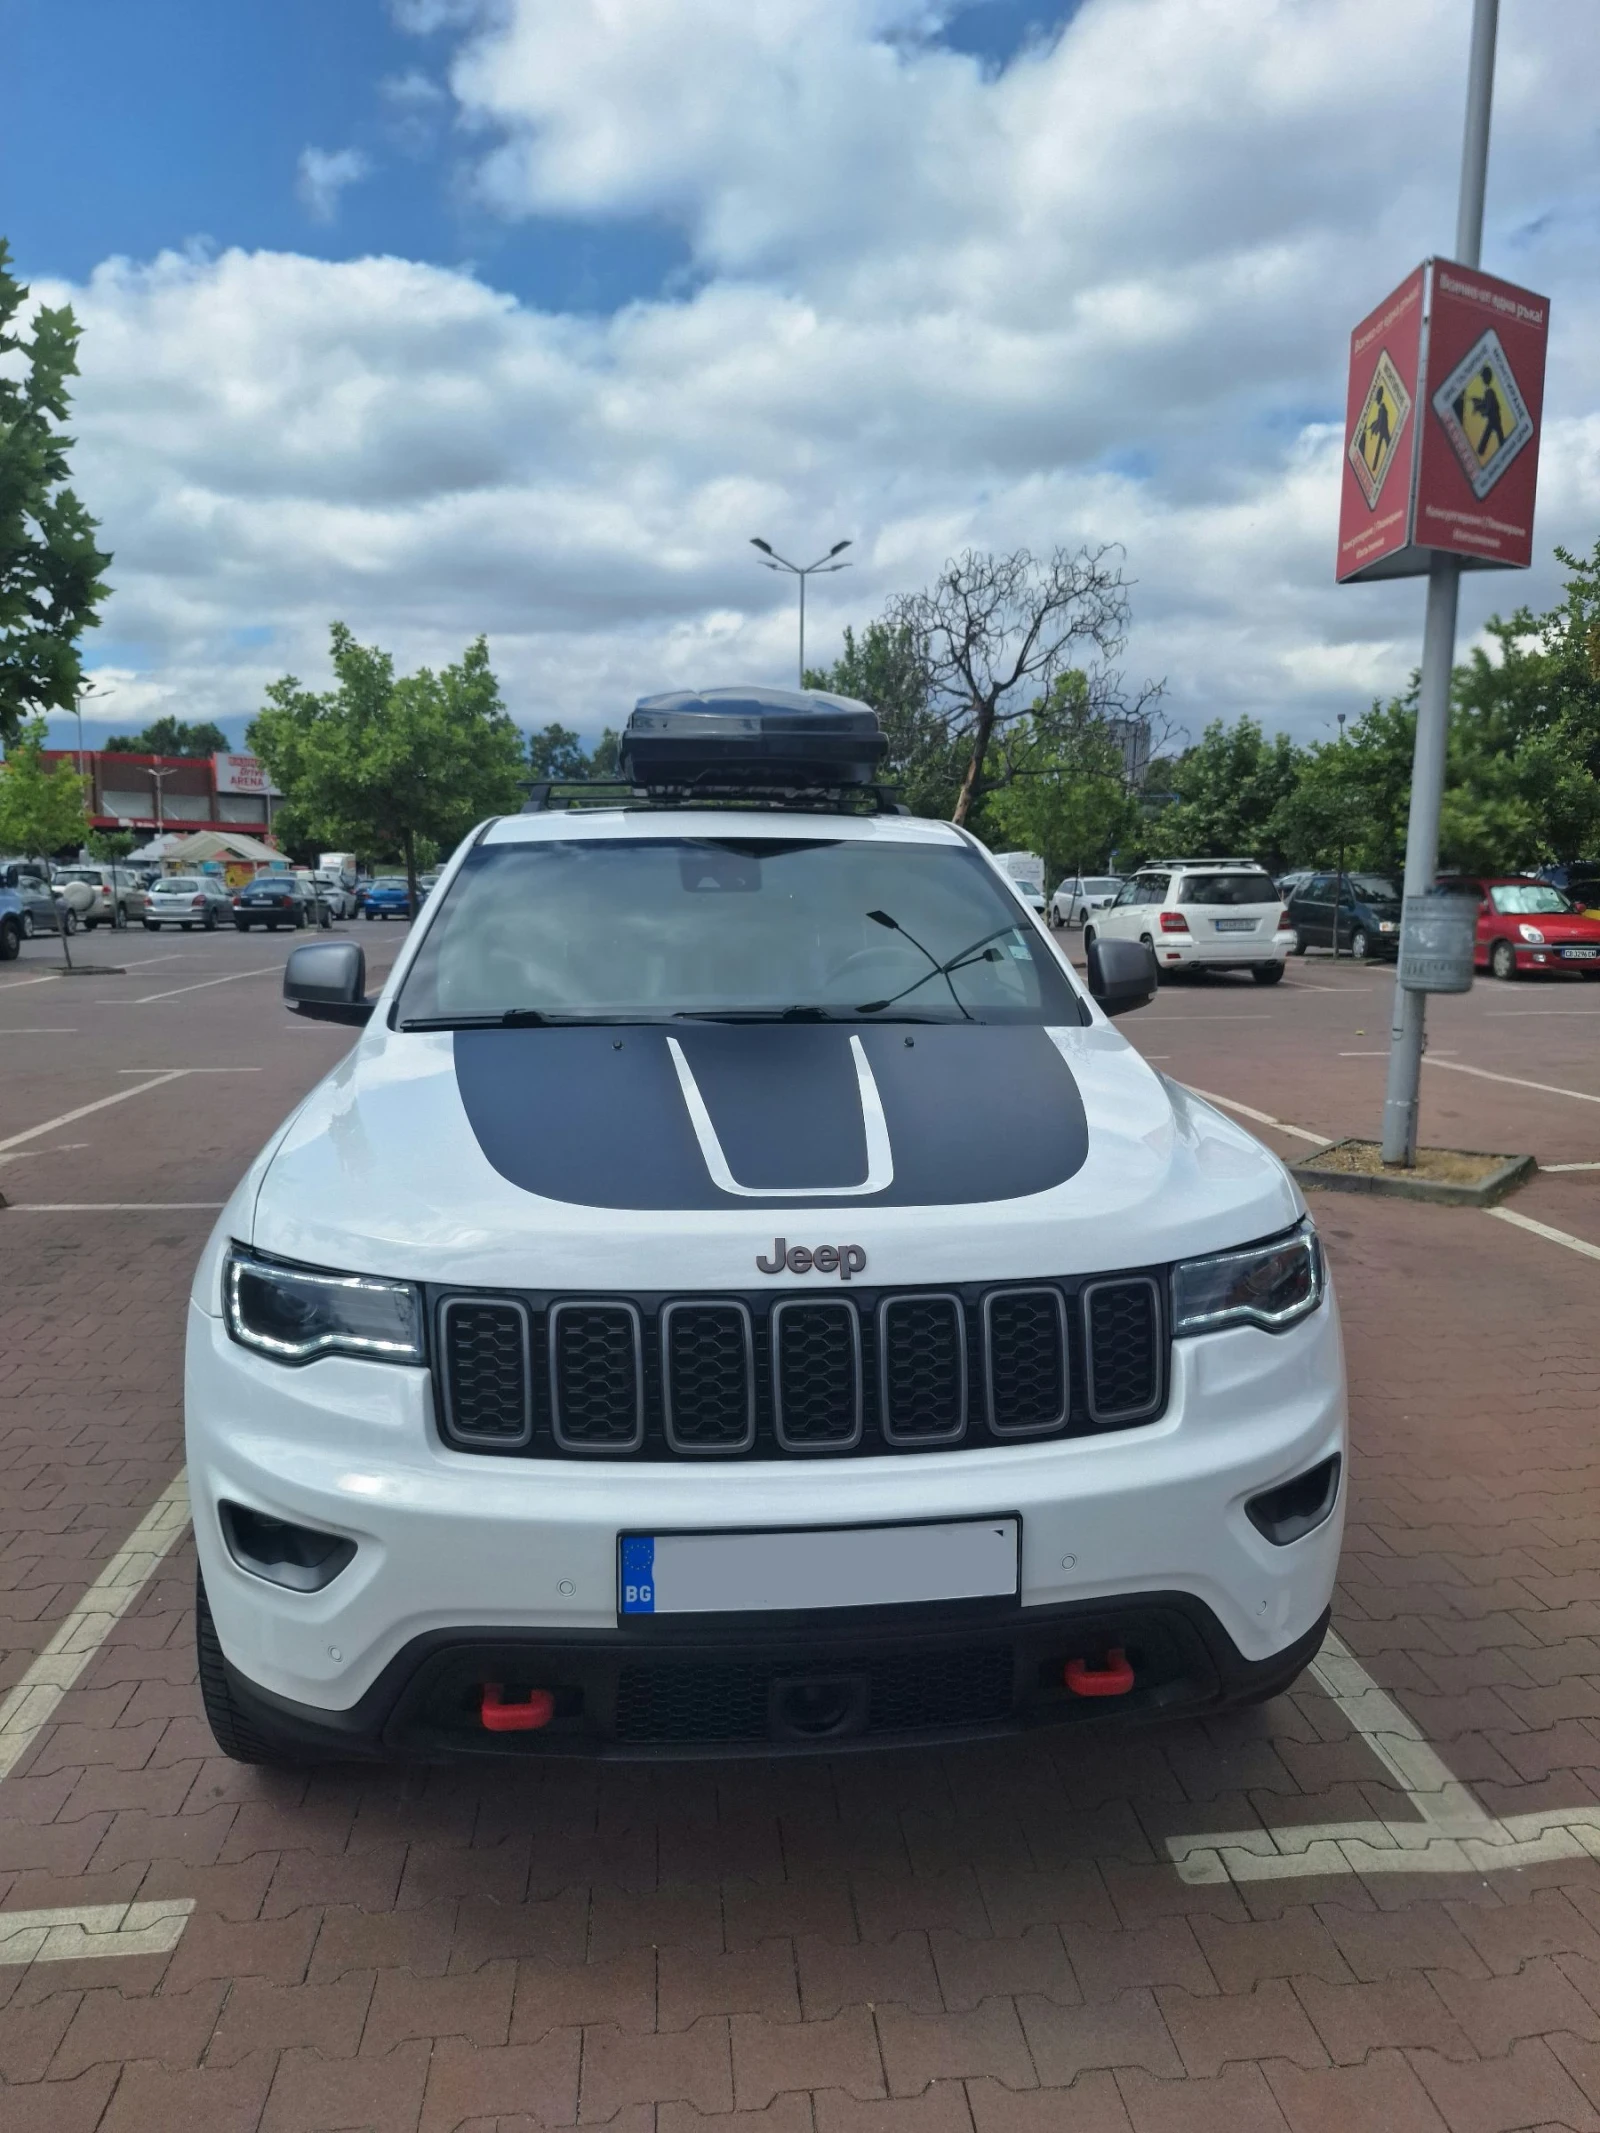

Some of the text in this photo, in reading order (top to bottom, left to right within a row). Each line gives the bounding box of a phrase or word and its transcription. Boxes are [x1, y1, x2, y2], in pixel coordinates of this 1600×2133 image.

[1517, 303, 1543, 324] ръка!
[230, 776, 264, 786] ARENA
[756, 1238, 866, 1280] Jeep
[626, 1585, 651, 1602] BG
